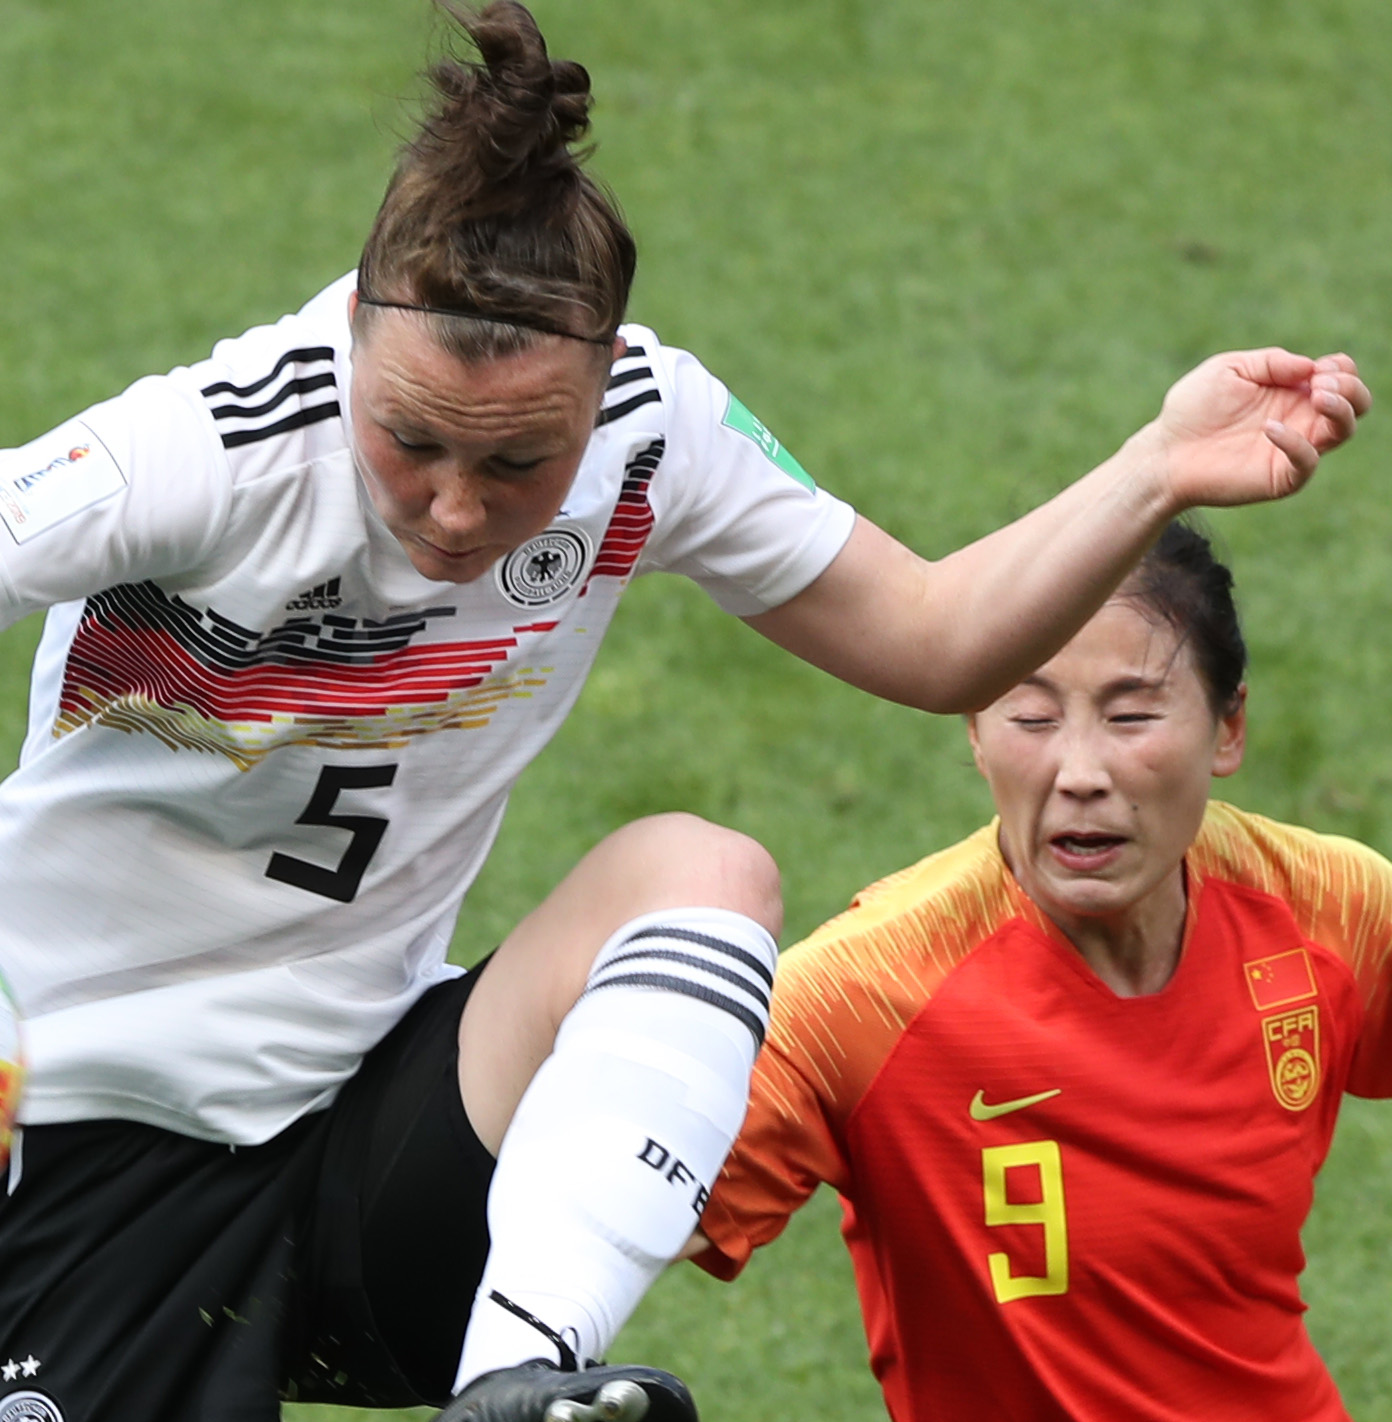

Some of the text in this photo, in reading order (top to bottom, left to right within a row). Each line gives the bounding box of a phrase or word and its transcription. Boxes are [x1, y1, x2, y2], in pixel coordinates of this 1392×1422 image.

[264, 763, 399, 904] 5
[1267, 1012, 1313, 1041] CFA
[635, 1137, 710, 1220] DFB
[981, 1140, 1069, 1304] 9
